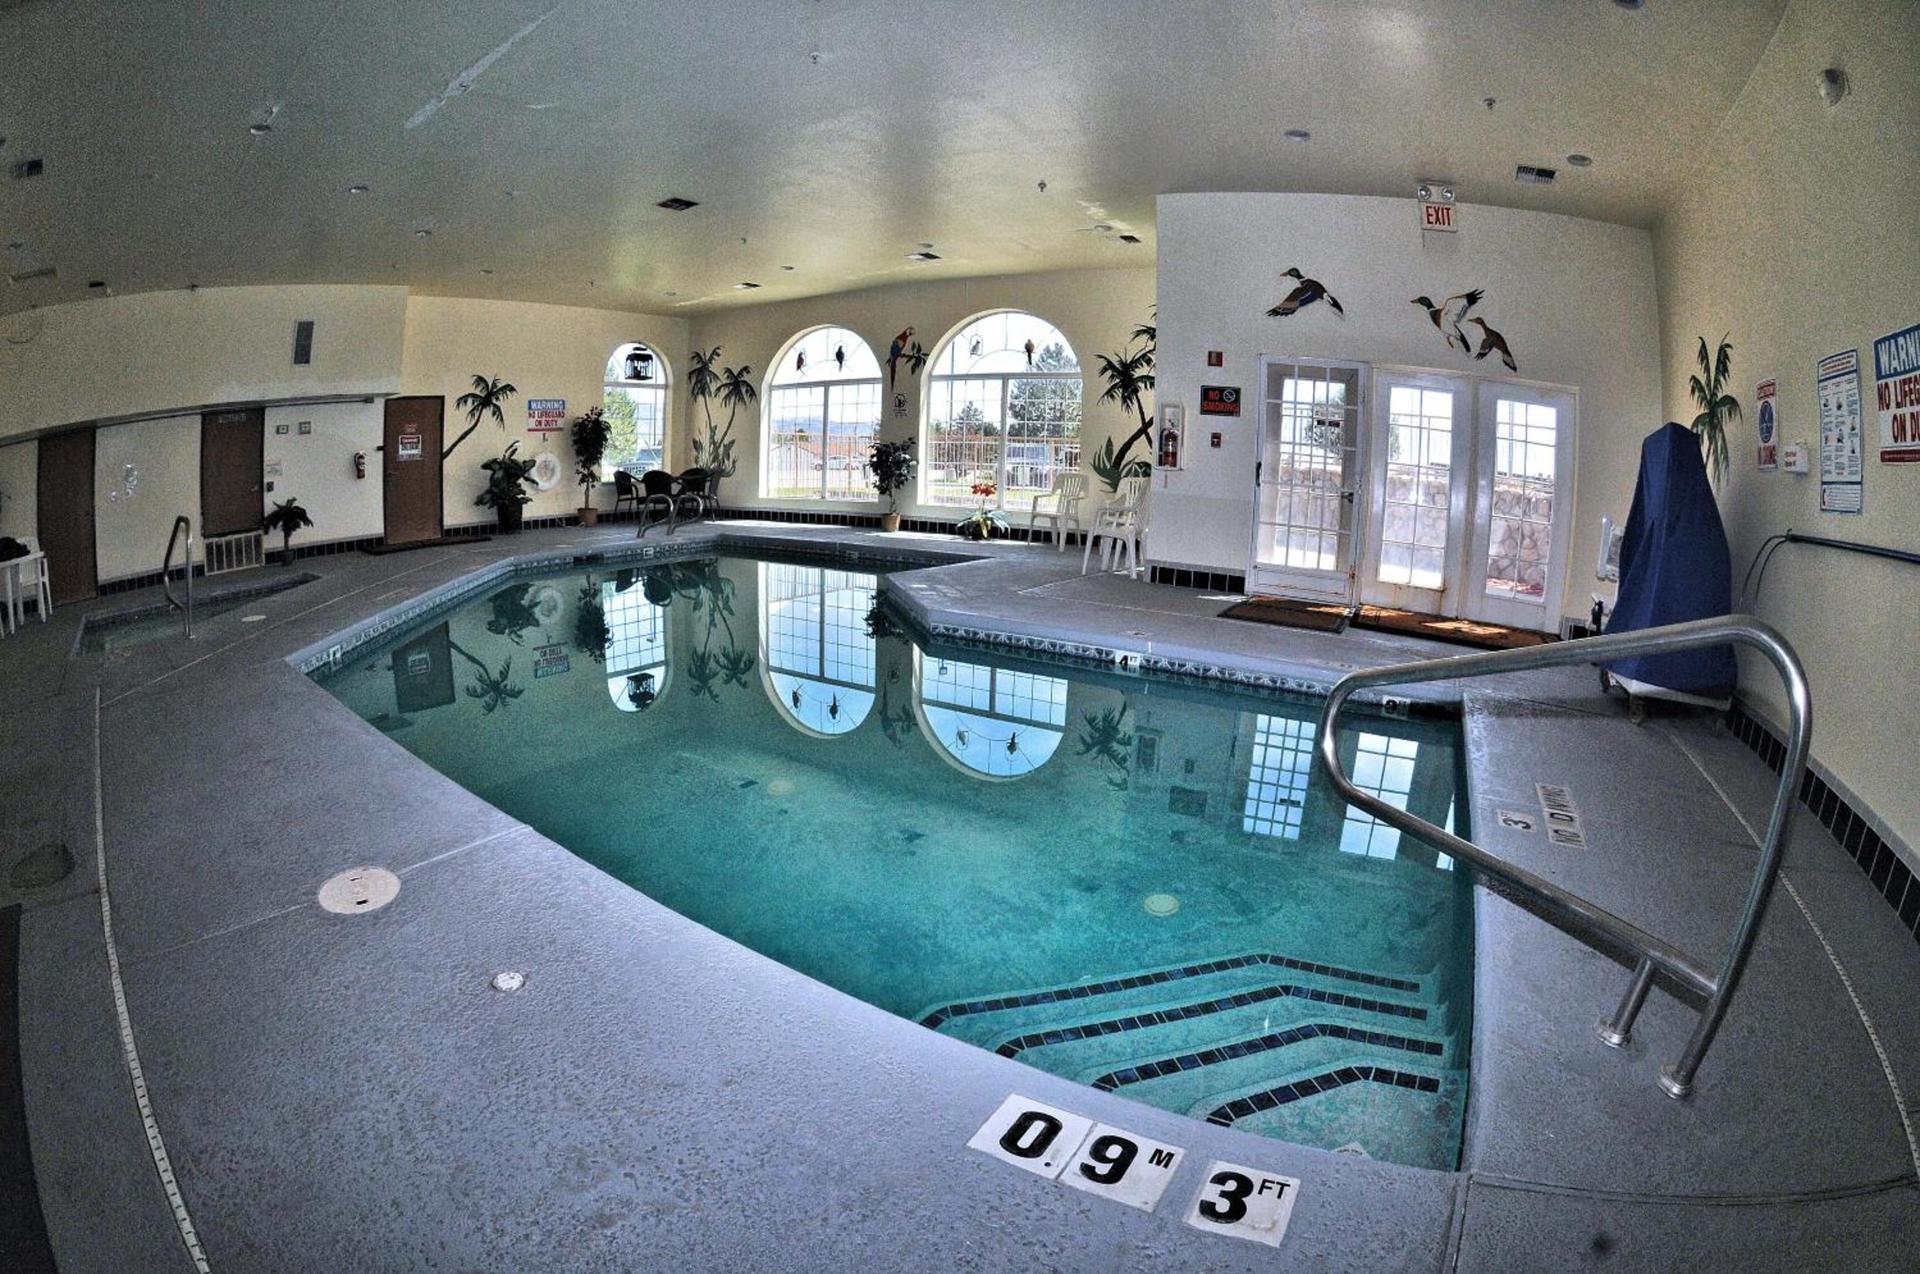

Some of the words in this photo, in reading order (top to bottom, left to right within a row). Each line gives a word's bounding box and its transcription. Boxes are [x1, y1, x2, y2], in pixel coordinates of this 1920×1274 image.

[1425, 205, 1451, 226] EXIT
[1208, 391, 1220, 400] NO
[1877, 382, 1891, 412] NO
[1892, 413, 1906, 443] ON
[1502, 817, 1532, 830] 3
[1148, 1148, 1175, 1169] M
[1199, 1171, 1254, 1224] 3
[1257, 1179, 1291, 1200] FT
